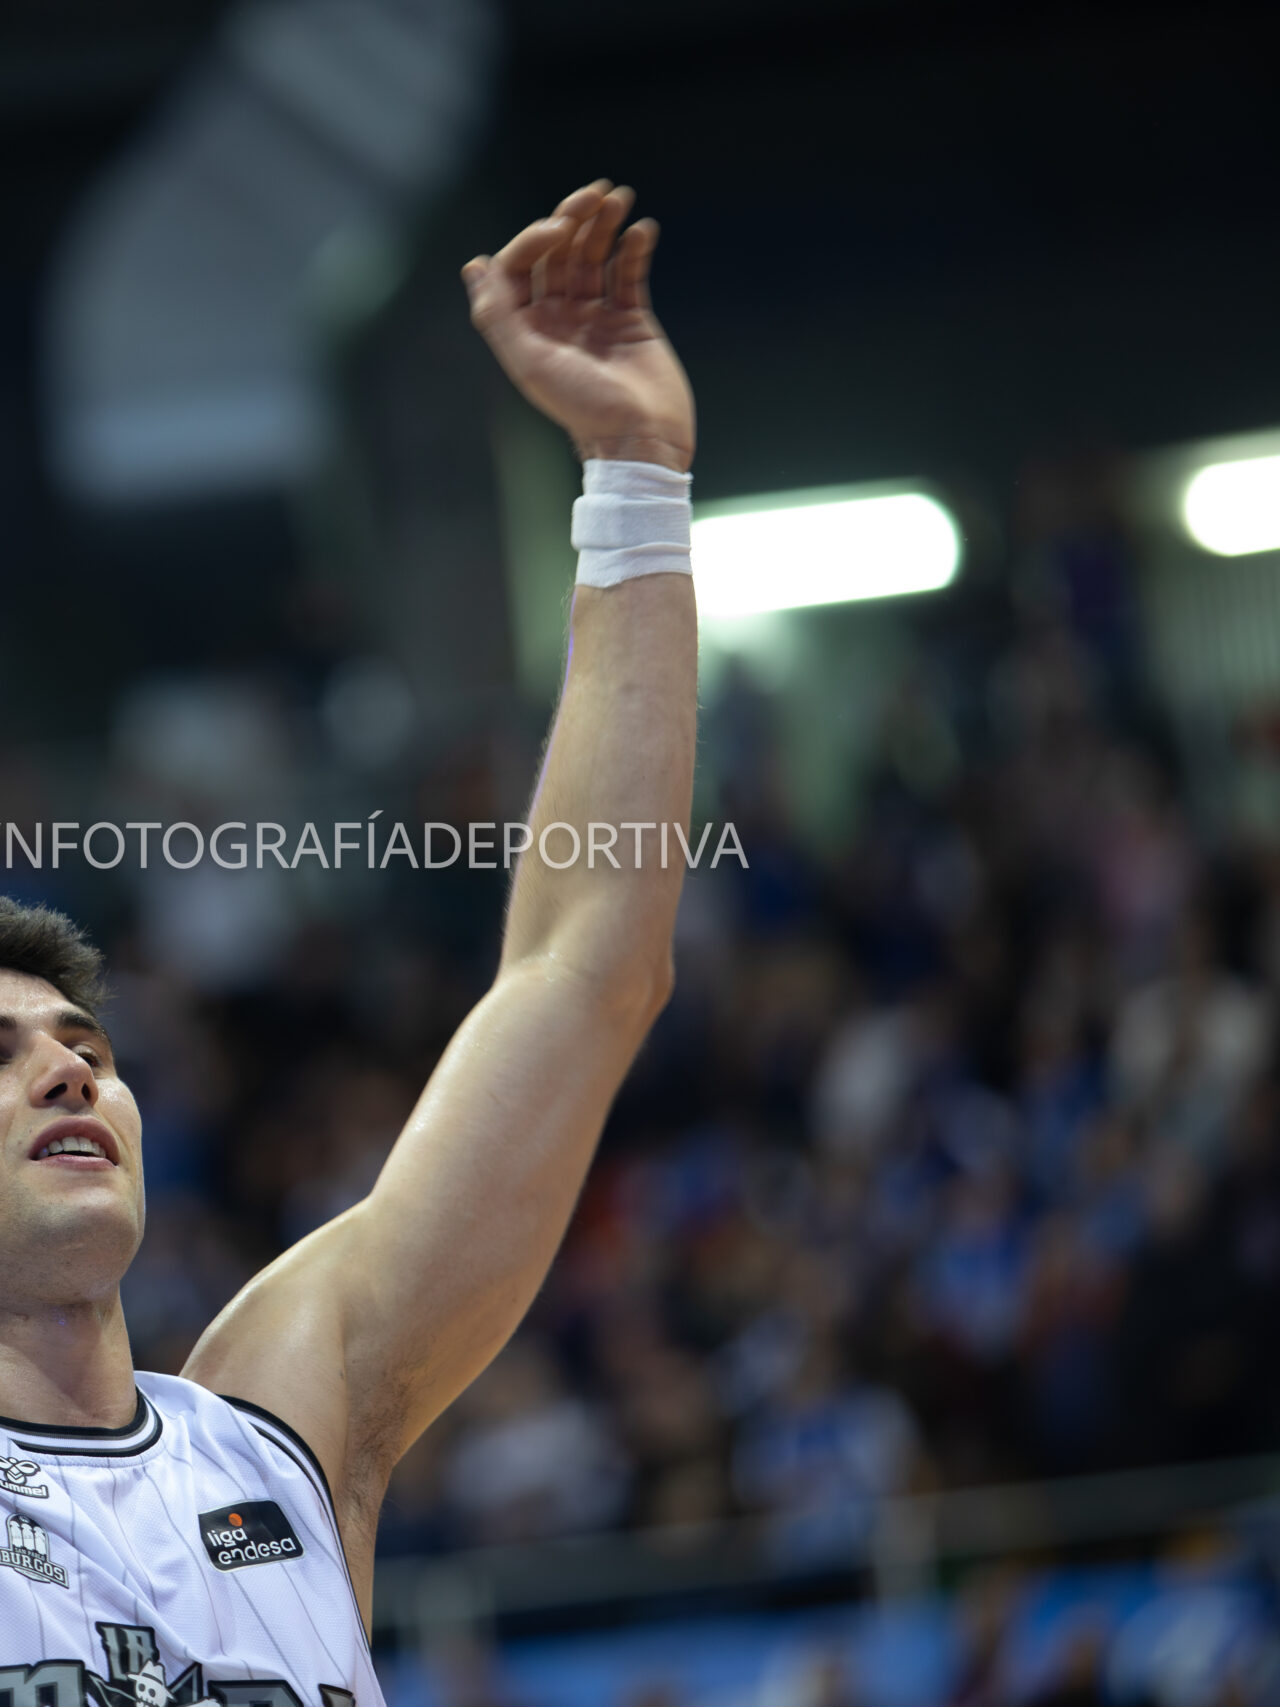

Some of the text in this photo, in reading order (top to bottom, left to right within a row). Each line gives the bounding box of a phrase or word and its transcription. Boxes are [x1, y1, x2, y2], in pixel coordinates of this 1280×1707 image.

[207, 1528, 247, 1547] liga
[218, 1537, 296, 1564] endesa
[0, 1550, 64, 1581] BURGOS
